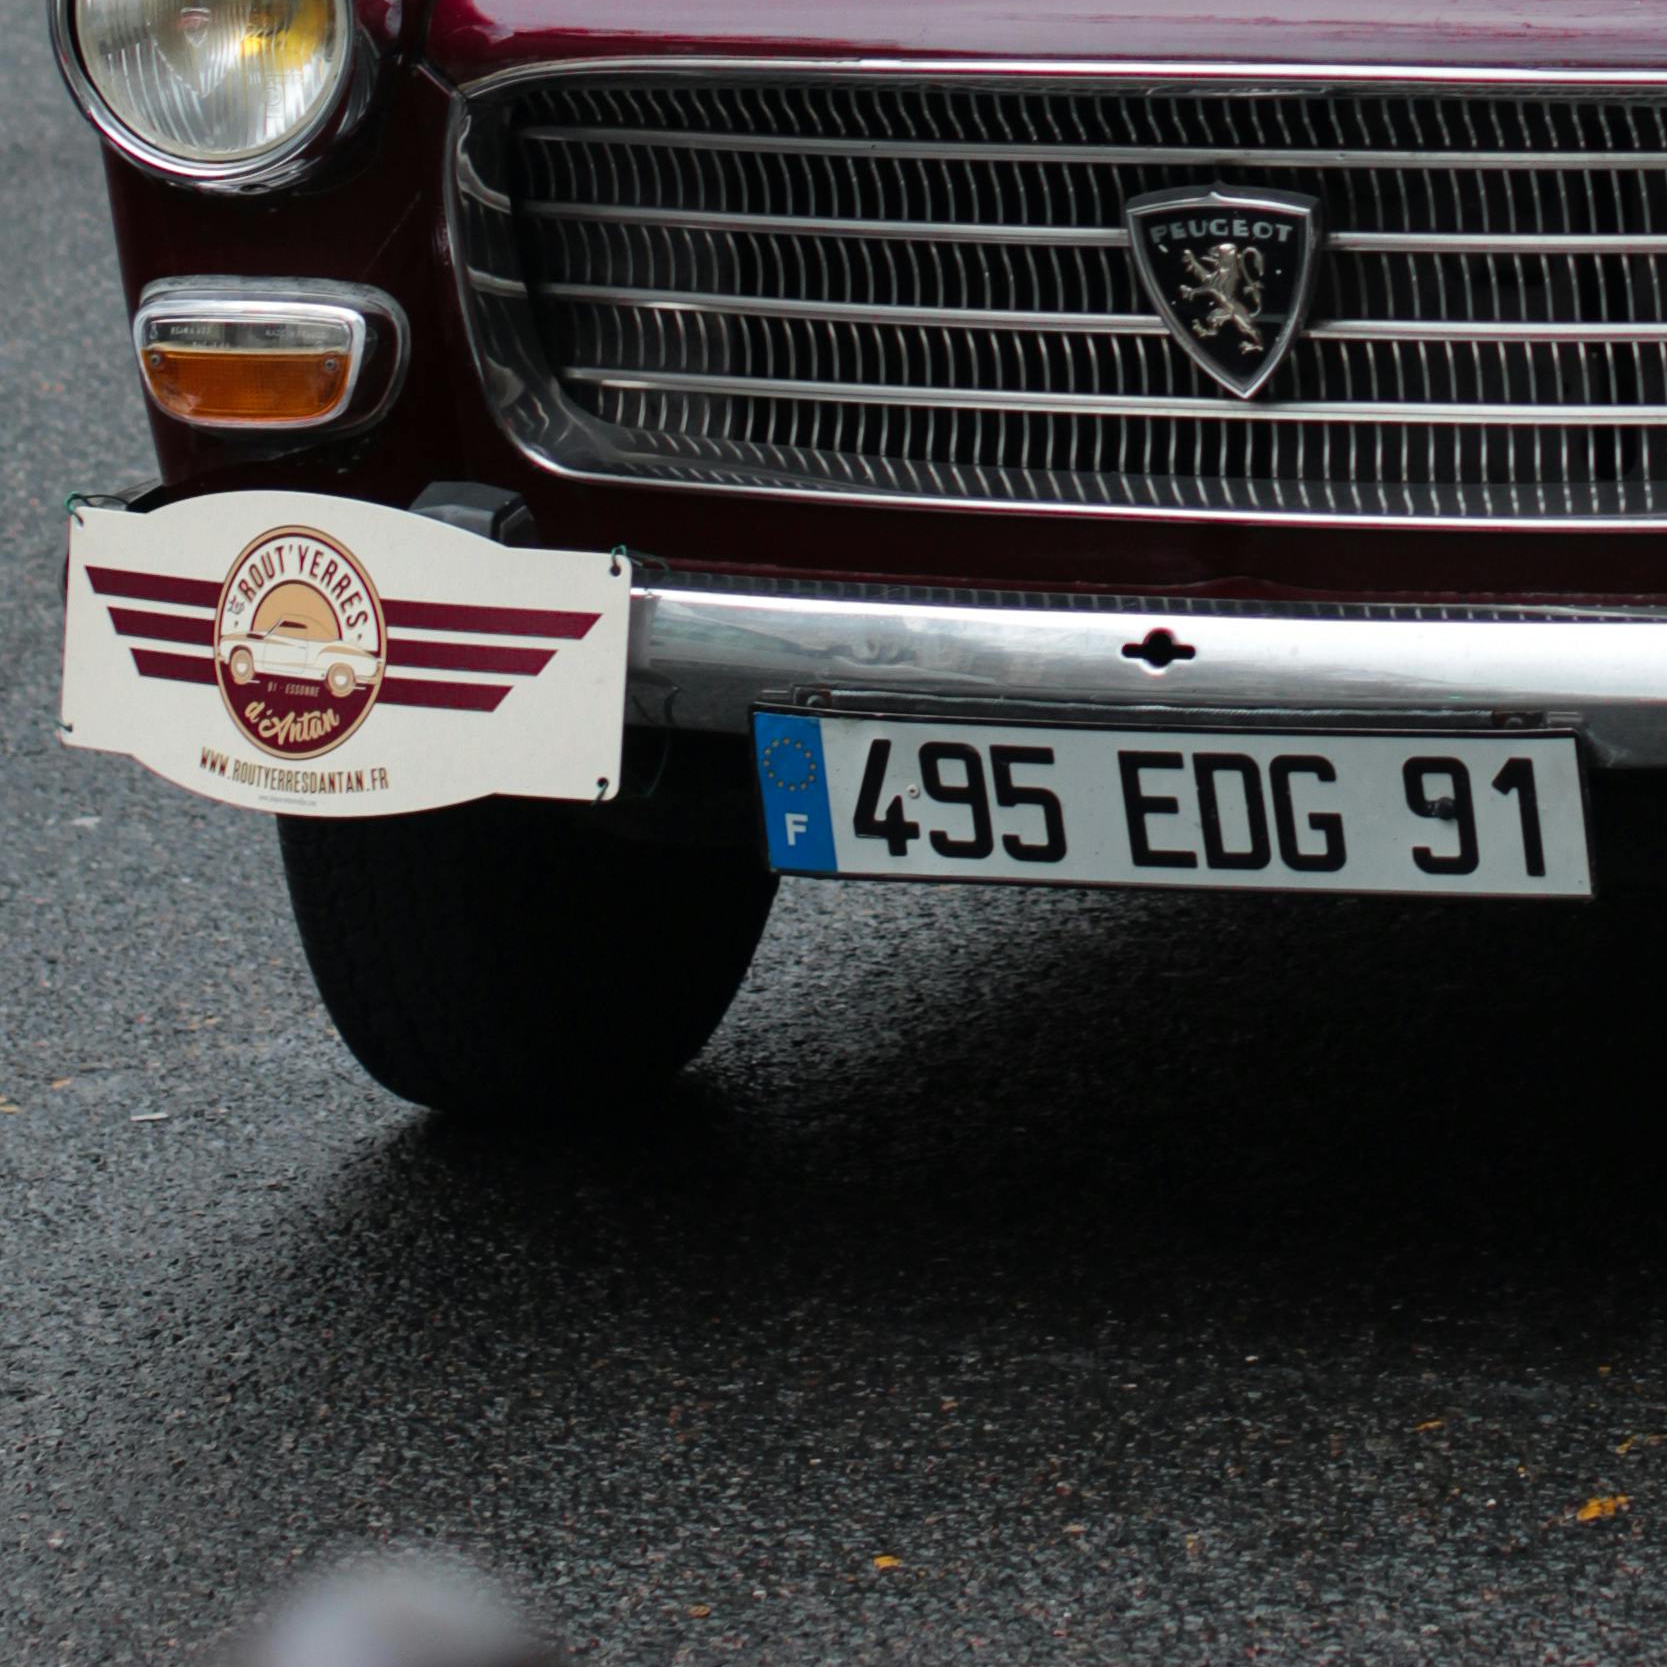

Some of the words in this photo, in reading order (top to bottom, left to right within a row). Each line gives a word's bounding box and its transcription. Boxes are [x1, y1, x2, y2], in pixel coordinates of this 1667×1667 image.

[1150, 218, 1293, 244] PEUGEOT
[238, 544, 368, 629] ROUT'YERRES
[200, 746, 389, 794] WWW.ROUTYERRESDANTAN.FR
[784, 812, 809, 847] F
[853, 739, 1067, 863] 495
[1118, 751, 1347, 872] EDG
[1402, 755, 1546, 877] 91
